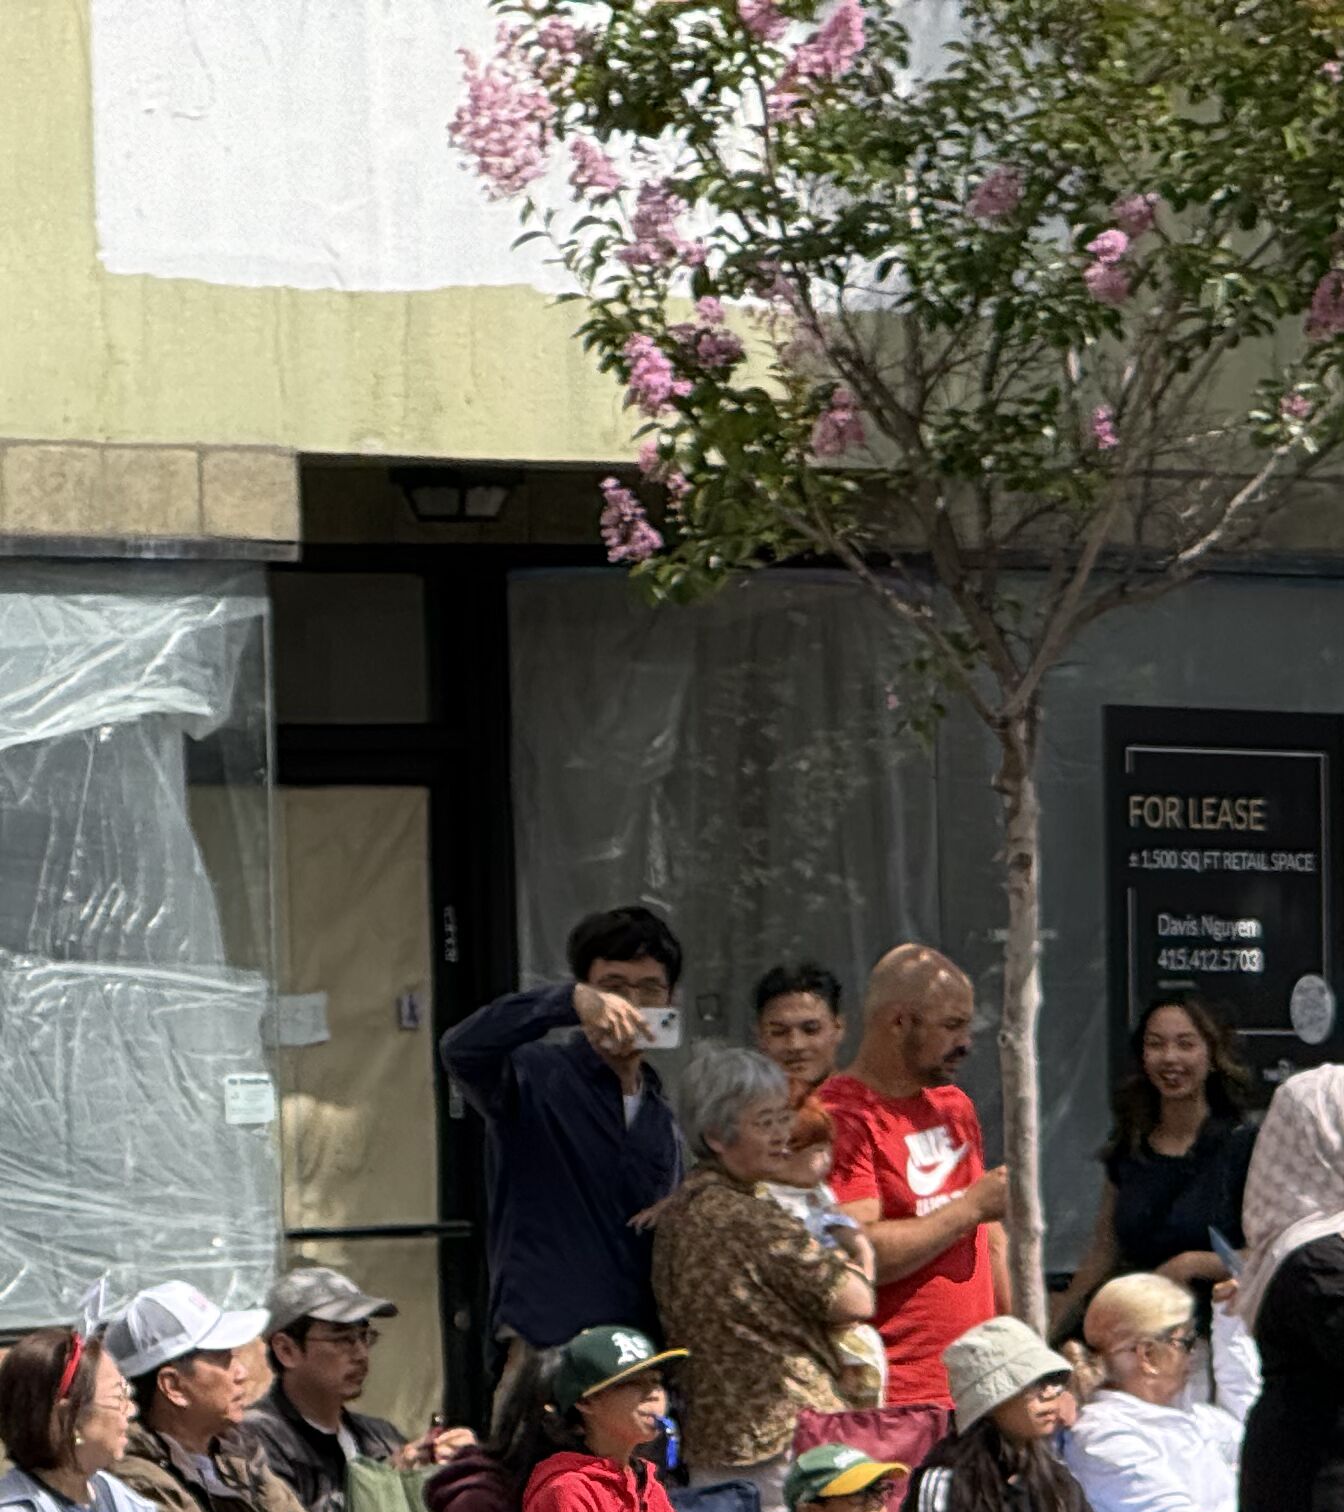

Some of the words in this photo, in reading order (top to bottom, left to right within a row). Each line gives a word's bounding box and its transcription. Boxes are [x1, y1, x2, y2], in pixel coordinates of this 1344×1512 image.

[1129, 795, 1182, 828] FOR
[1188, 797, 1267, 832] LEASE
[1223, 852, 1269, 872] RETAIL
[1271, 853, 1316, 873] SPACE
[1157, 913, 1198, 937] Davis
[1200, 914, 1261, 942] Nguyen
